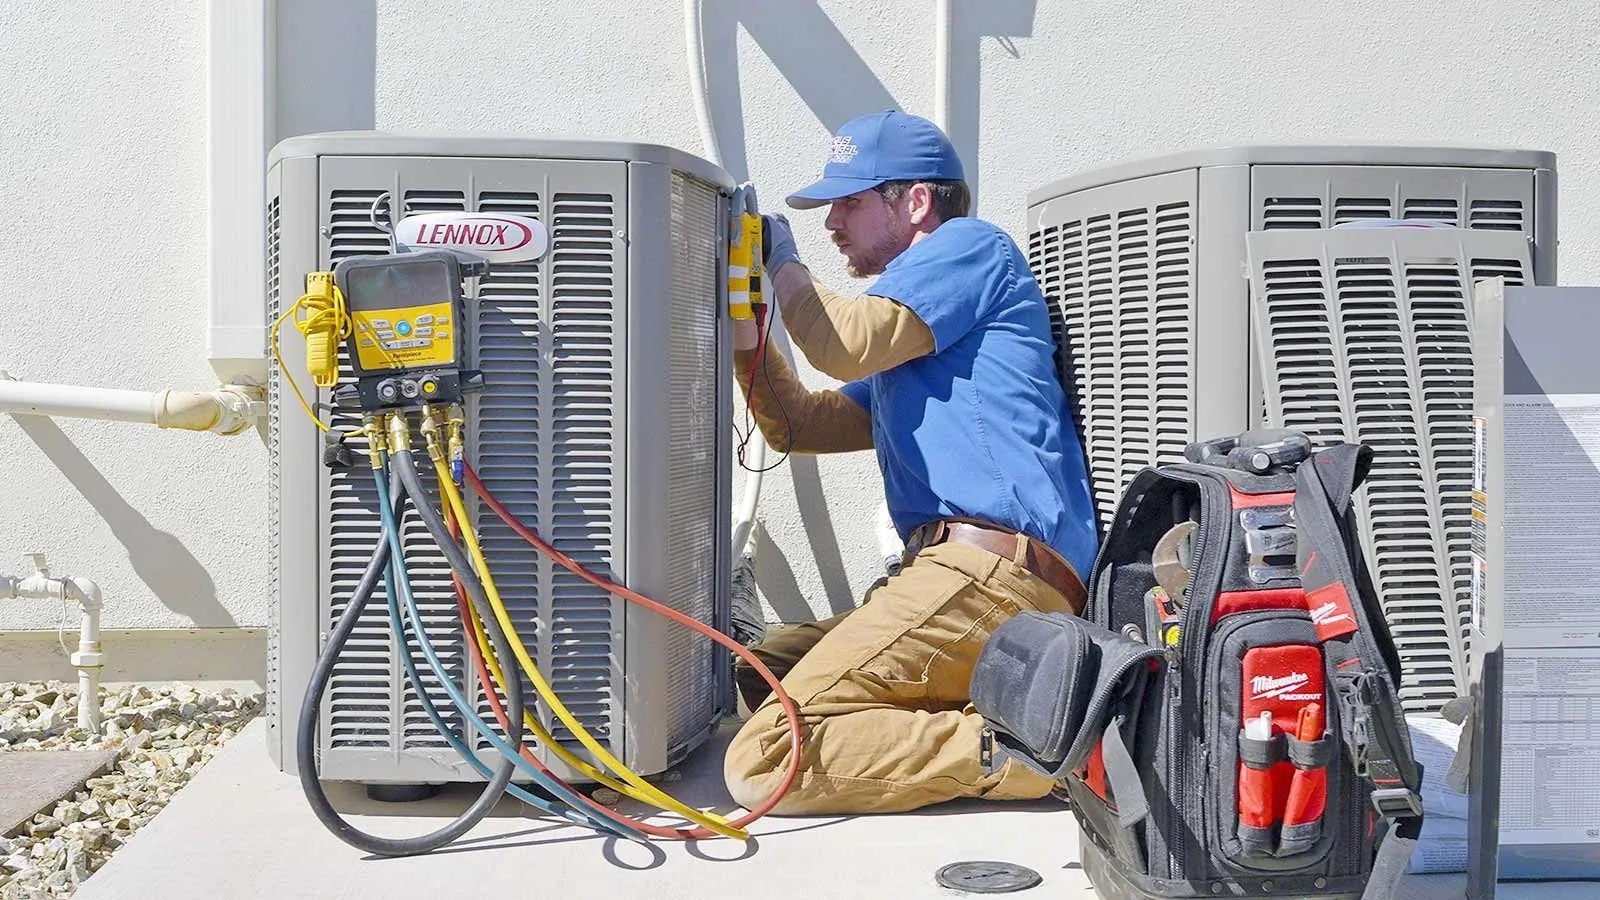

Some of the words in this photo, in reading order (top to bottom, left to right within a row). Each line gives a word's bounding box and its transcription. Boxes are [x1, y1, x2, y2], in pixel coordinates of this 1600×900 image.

[416, 224, 509, 246] LENNOX
[1249, 672, 1309, 694] Milwaukee
[1279, 693, 1322, 701] PACKOUT
